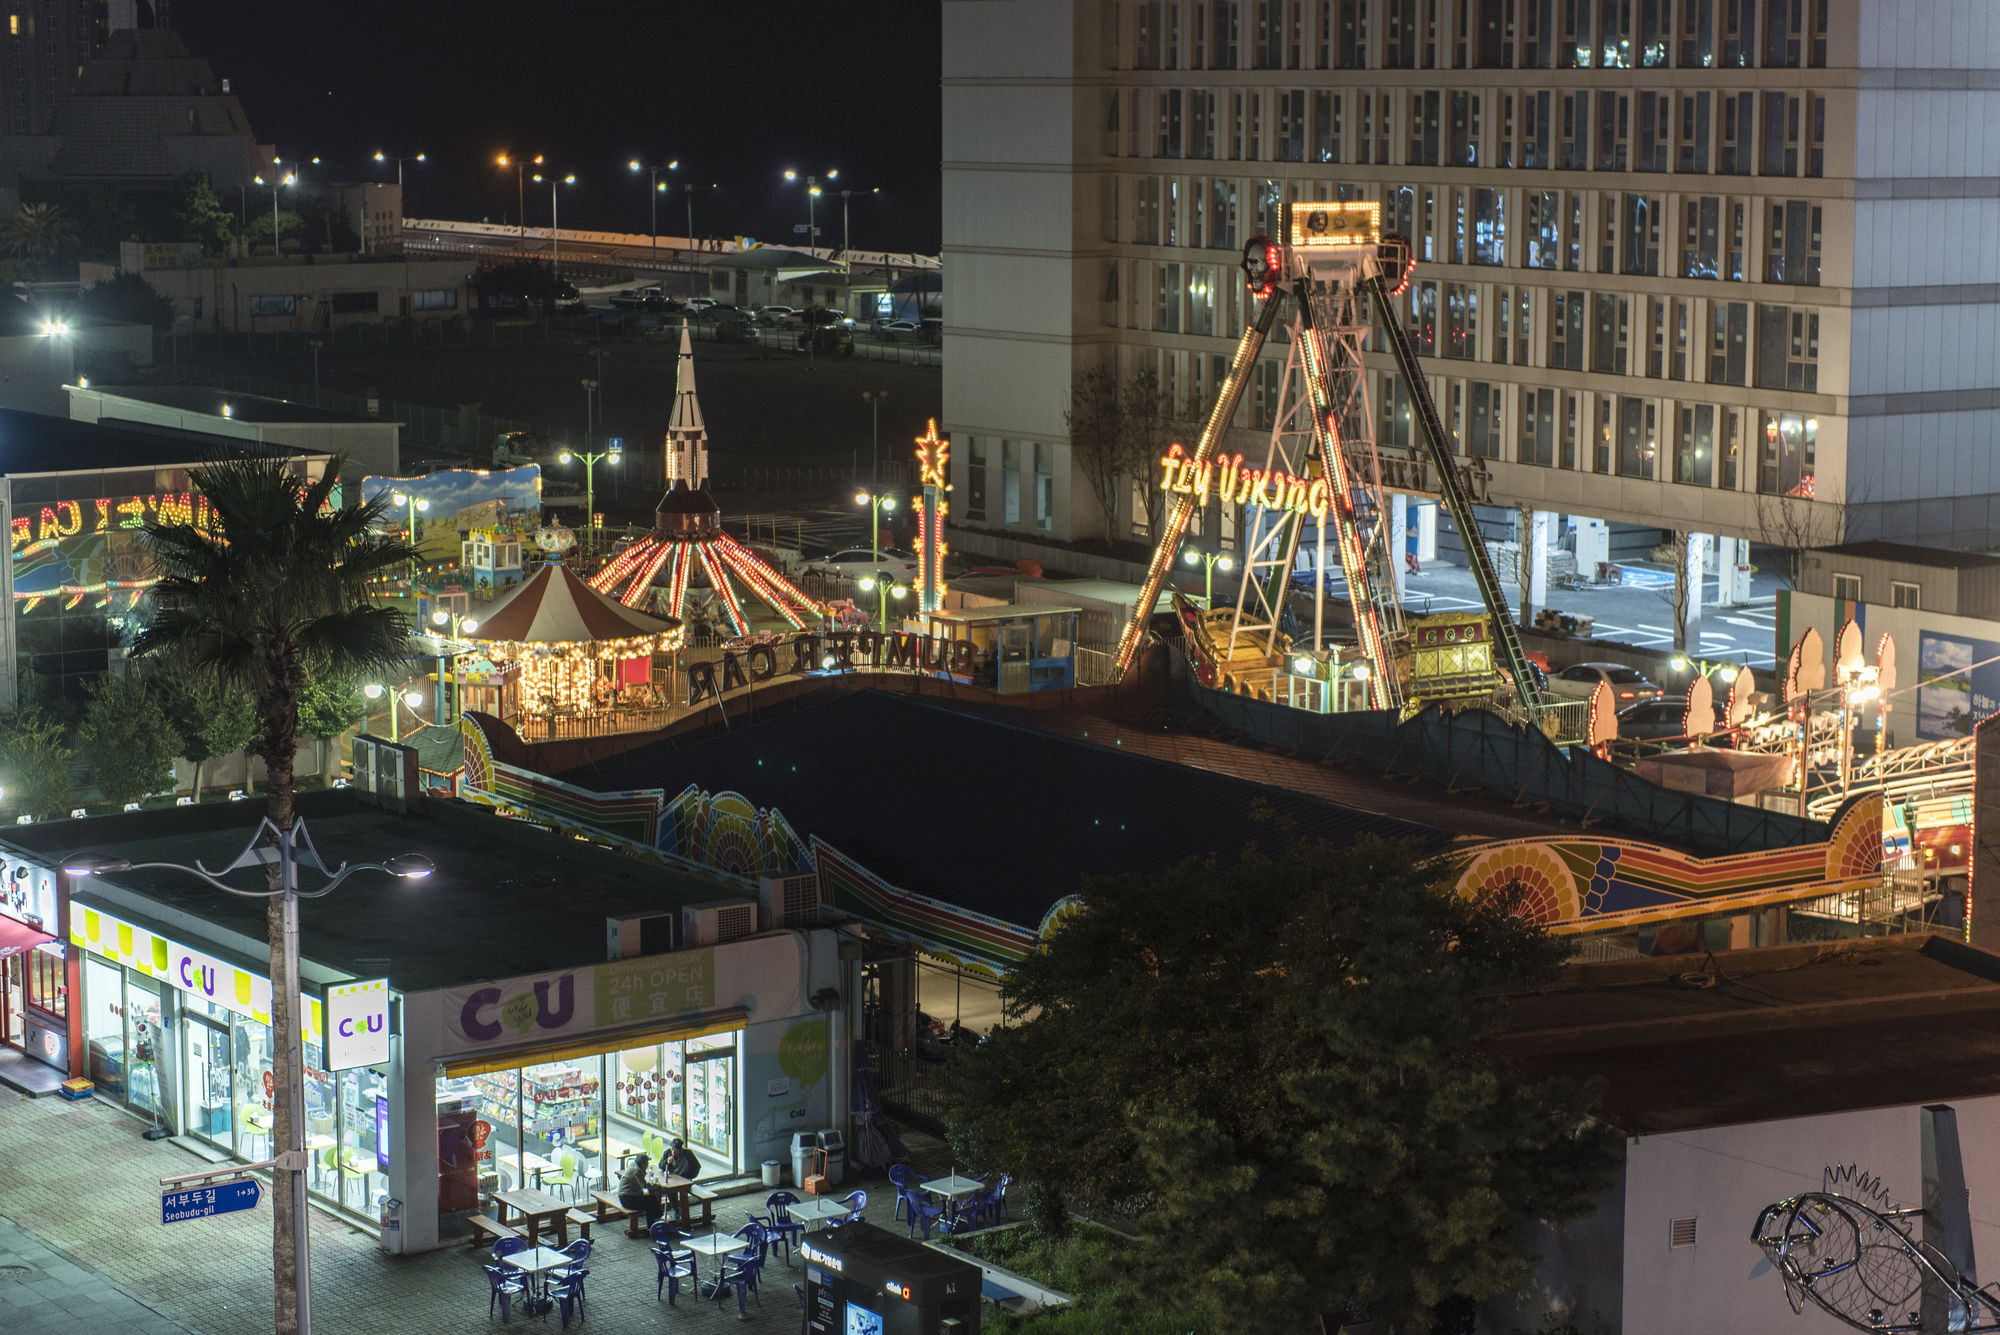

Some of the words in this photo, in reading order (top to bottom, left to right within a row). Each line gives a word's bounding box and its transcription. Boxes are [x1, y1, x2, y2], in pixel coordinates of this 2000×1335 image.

[180, 956, 215, 997] CU
[609, 973, 644, 995] 24h
[650, 965, 703, 988] OPEN
[461, 974, 575, 1041] CU
[338, 1013, 383, 1037] CU
[790, 1108, 806, 1119] CU
[165, 1188, 216, 1208] 서부두길
[165, 1205, 215, 1222] Seobudu-gil
